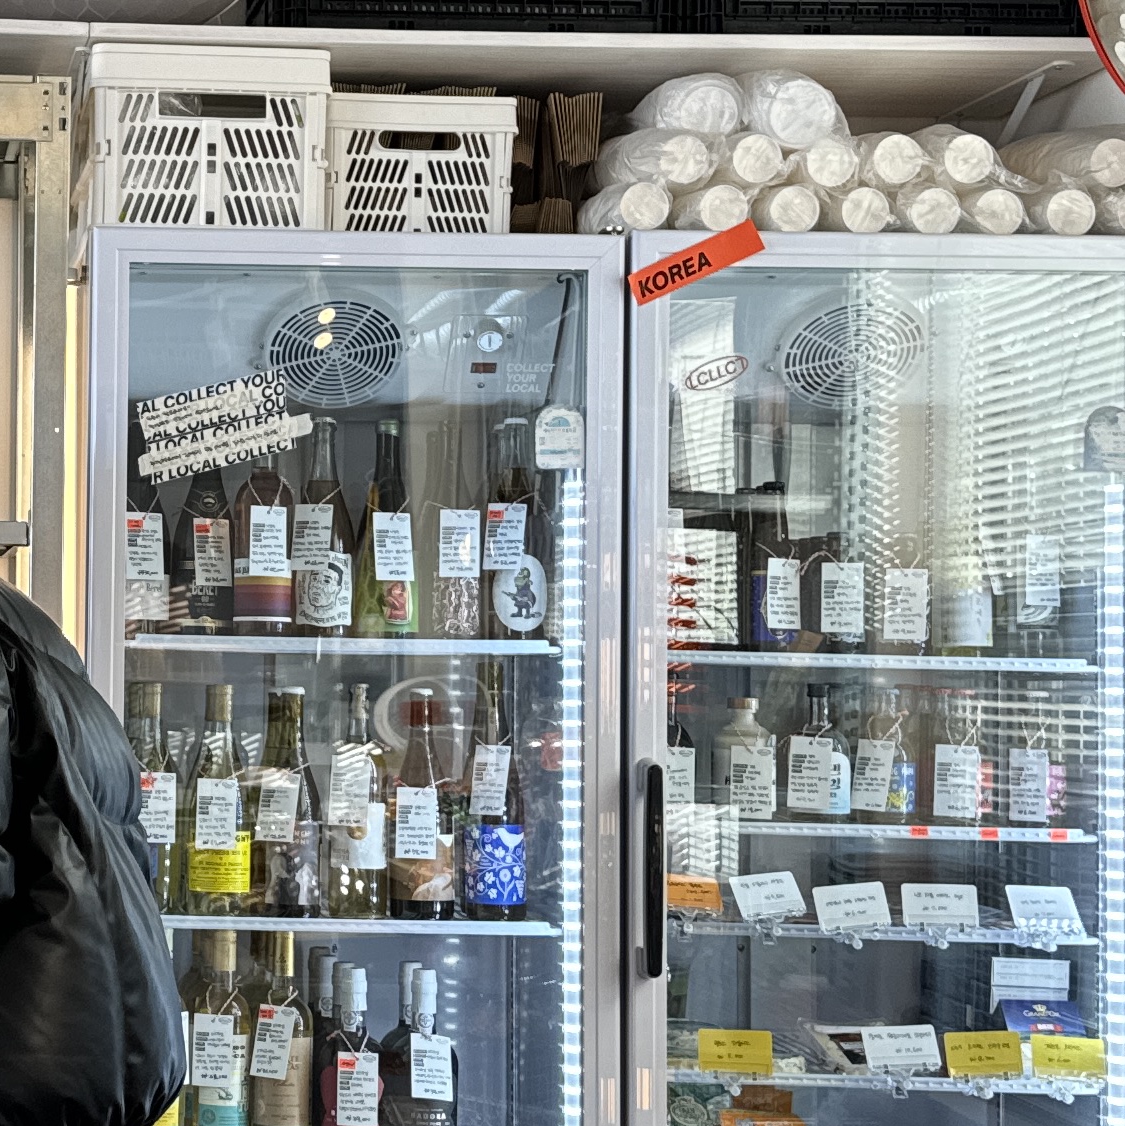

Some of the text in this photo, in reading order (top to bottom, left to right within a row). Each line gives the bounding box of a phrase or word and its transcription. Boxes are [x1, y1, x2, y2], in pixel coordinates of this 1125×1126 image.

[638, 250, 713, 298] KOREA
[506, 363, 556, 373] COLLECT
[507, 373, 537, 382] YOUR
[164, 379, 237, 409] COLLECT
[506, 383, 541, 393] LOCAL
[169, 458, 221, 480] LOCAL
